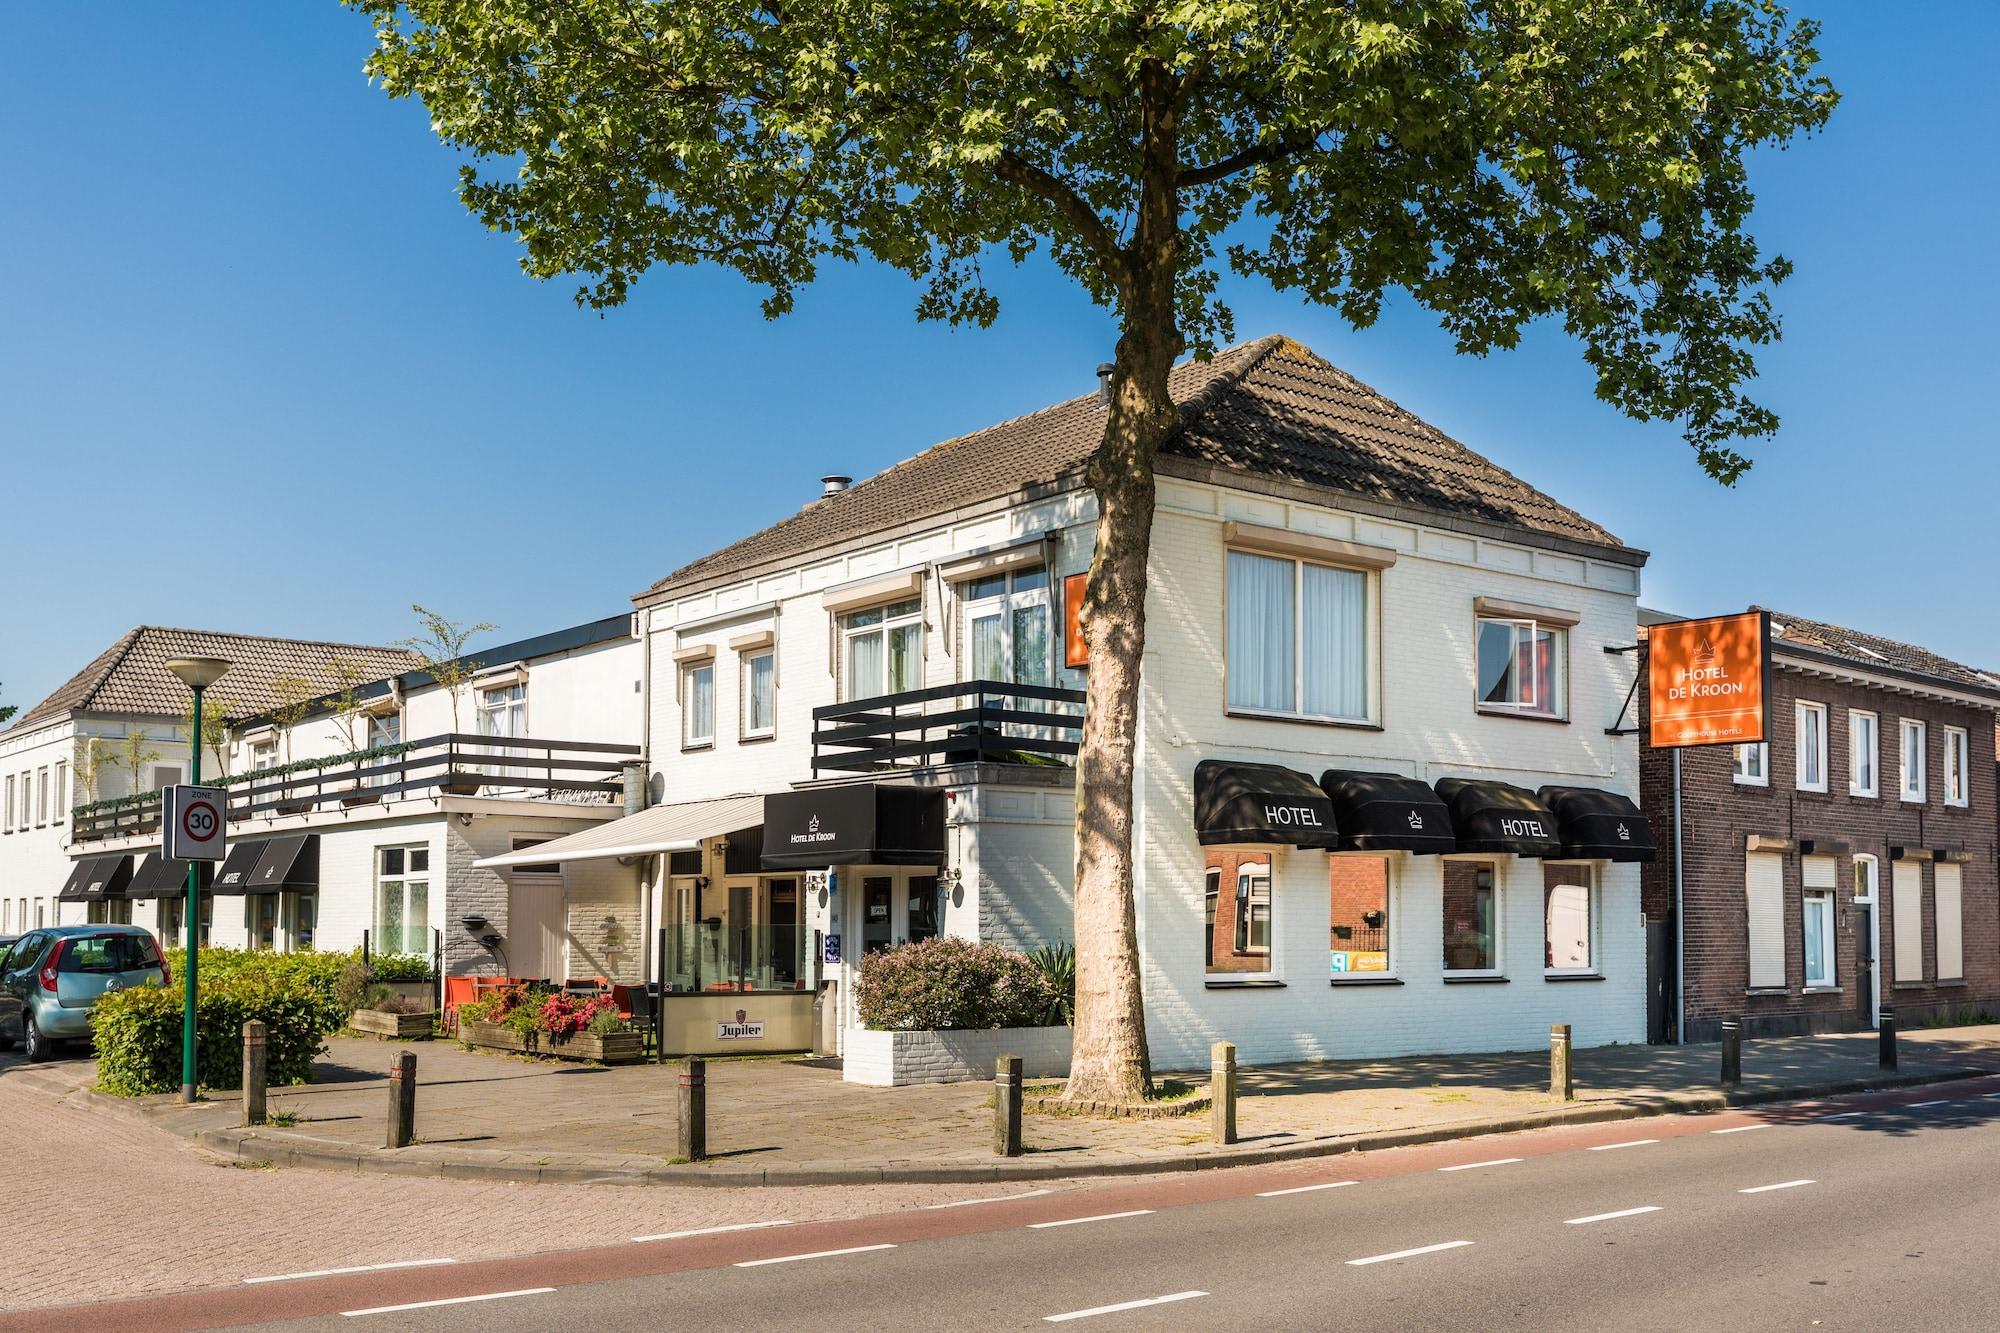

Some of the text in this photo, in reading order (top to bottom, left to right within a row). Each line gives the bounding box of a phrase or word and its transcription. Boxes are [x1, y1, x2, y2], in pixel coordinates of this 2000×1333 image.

[1682, 667, 1728, 681] HOTEL
[1669, 682, 1743, 700] DE KROON
[1719, 728, 1743, 736] HOTELS
[191, 791, 213, 799] ZONE
[190, 813, 213, 830] 30
[1265, 806, 1322, 826] HOTEL
[1501, 818, 1548, 837] HOTEL
[791, 832, 836, 843] HOTEL DE KROON
[222, 872, 241, 884] HOTEL
[721, 1024, 761, 1038] Jupiler
